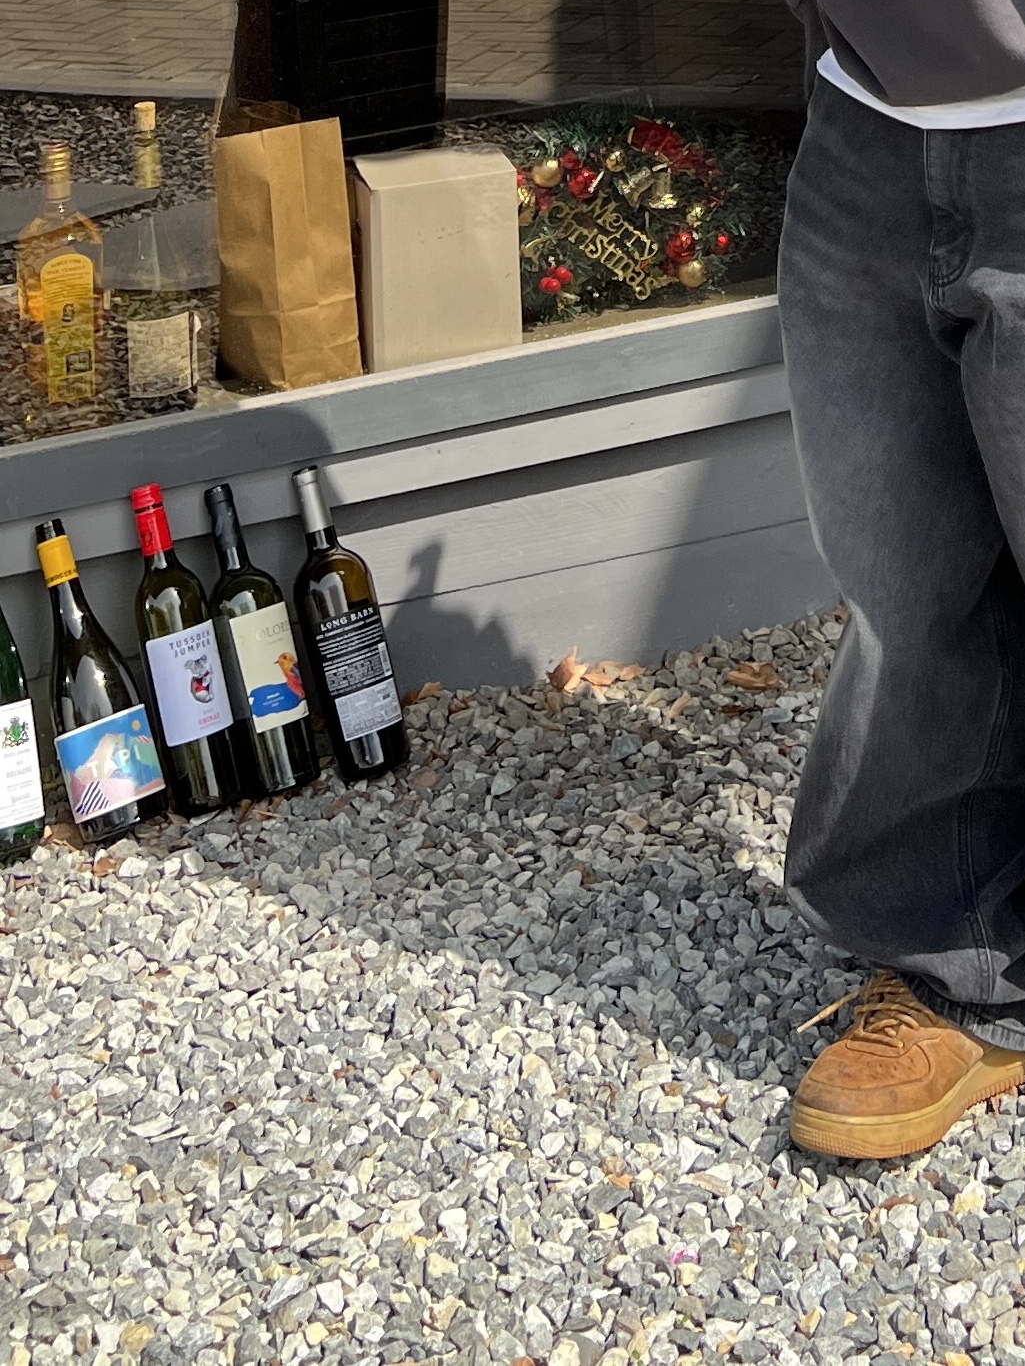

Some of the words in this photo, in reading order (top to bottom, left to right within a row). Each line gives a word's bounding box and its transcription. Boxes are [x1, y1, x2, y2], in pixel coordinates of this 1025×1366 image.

[585, 190, 659, 261] Merry
[319, 615, 344, 632] LONG
[350, 605, 376, 622] BARN
